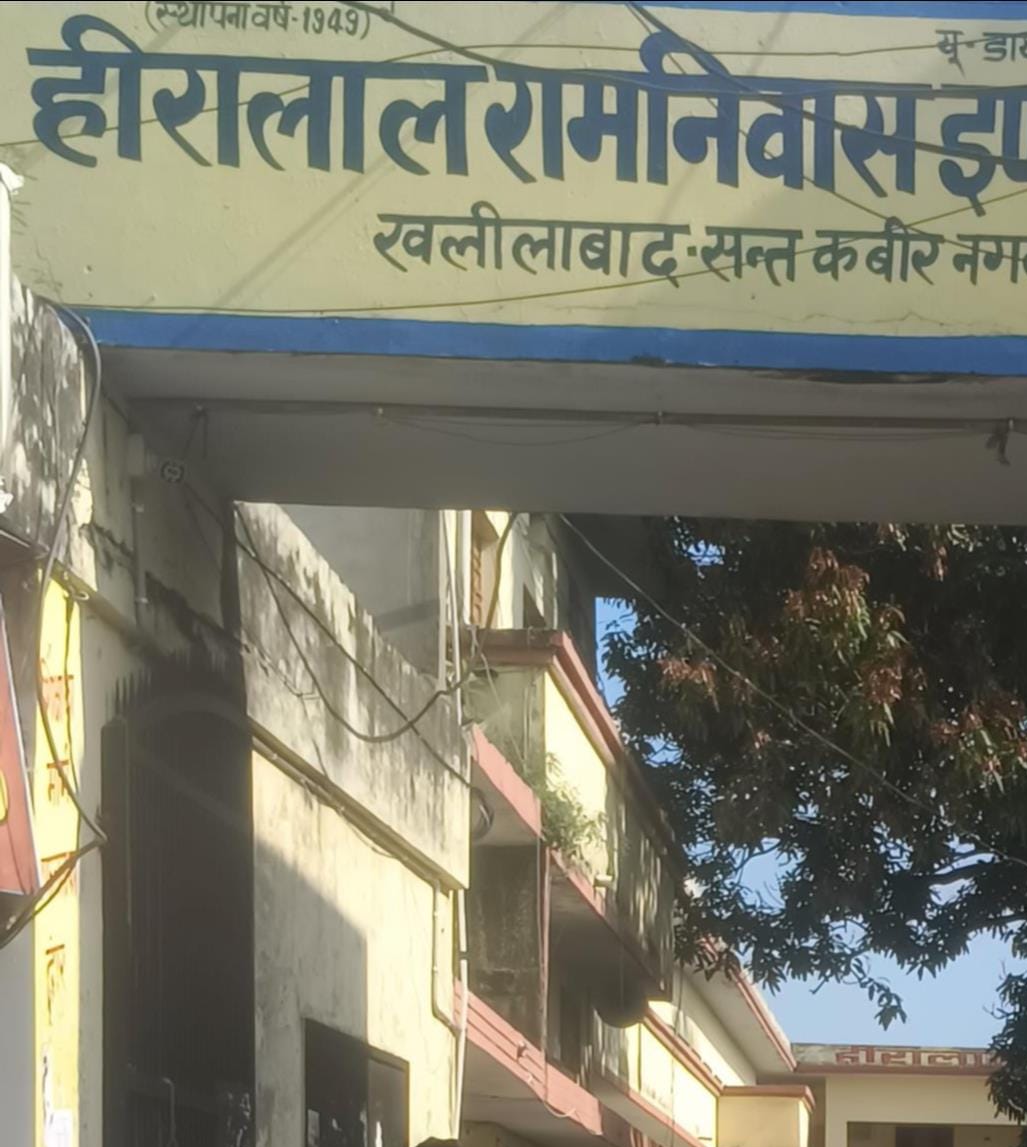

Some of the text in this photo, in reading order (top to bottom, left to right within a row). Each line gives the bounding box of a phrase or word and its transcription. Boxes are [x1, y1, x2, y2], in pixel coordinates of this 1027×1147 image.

[26, 14, 489, 176] हीरालाल
[485, 32, 932, 198] रामनिवास
[812, 216, 944, 286] कबीर
